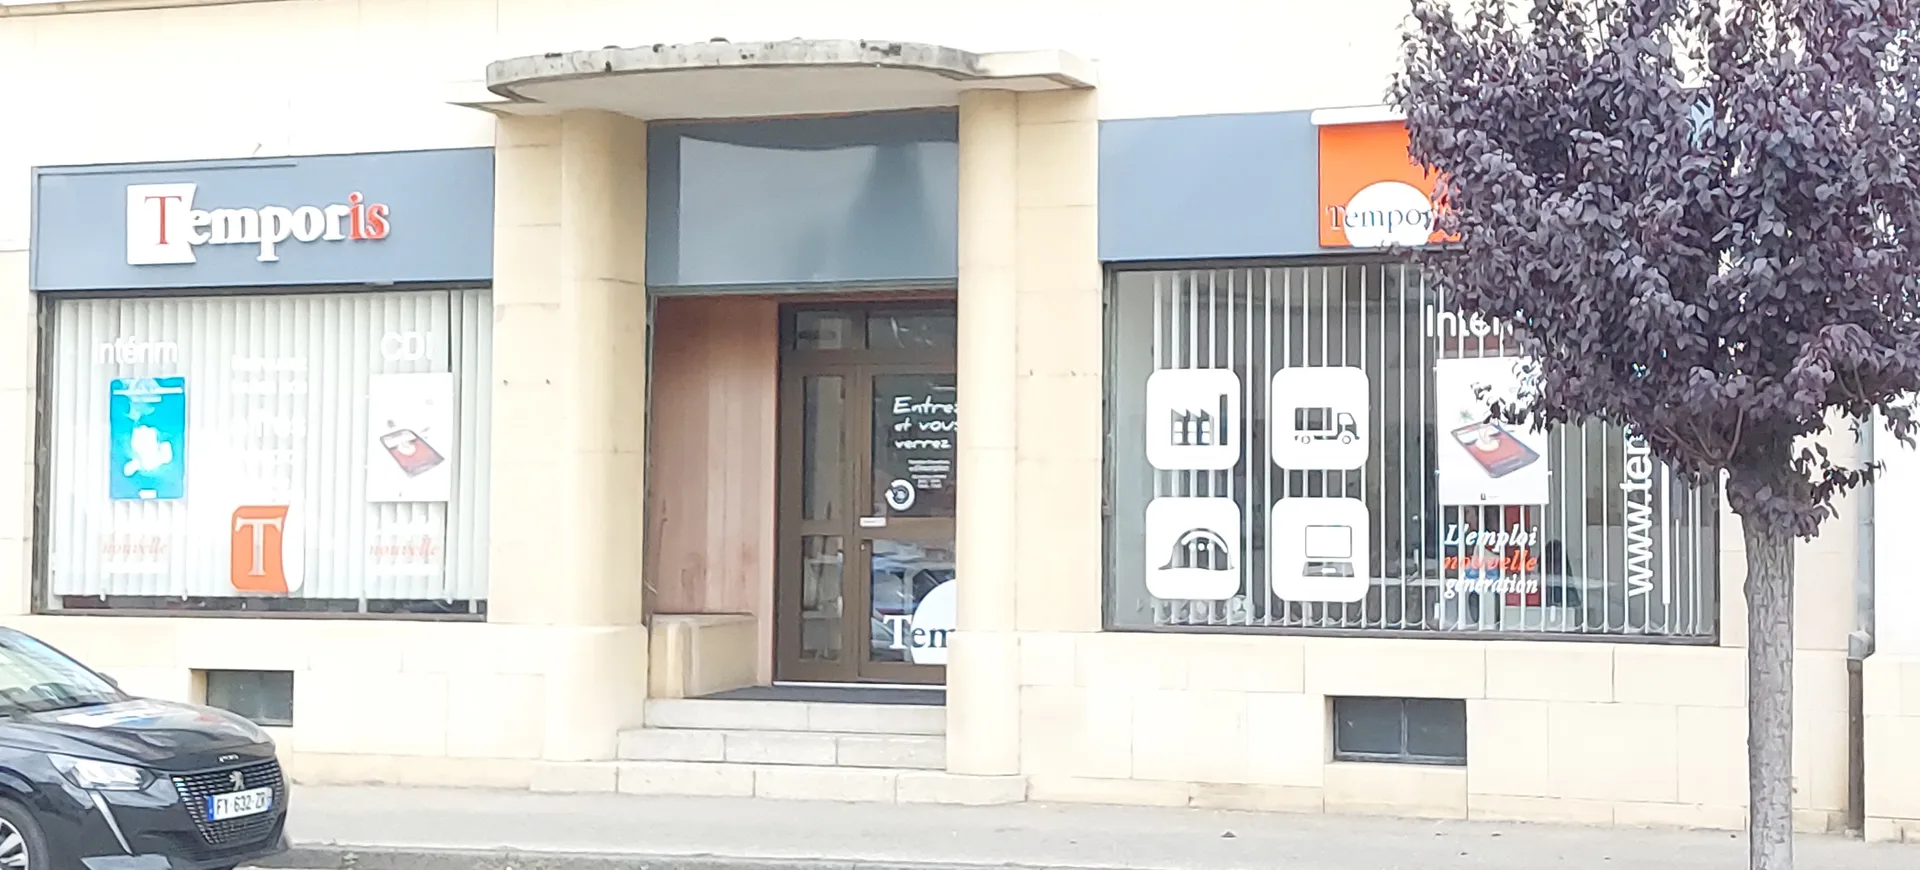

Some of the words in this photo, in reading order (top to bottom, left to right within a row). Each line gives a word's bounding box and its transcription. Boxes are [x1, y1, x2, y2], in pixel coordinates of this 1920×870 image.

[142, 190, 391, 263] Temporis
[894, 417, 912, 432] et
[894, 439, 951, 449] verrez
[1444, 523, 1538, 553] L'emploi
[1444, 549, 1538, 571] nouvelle
